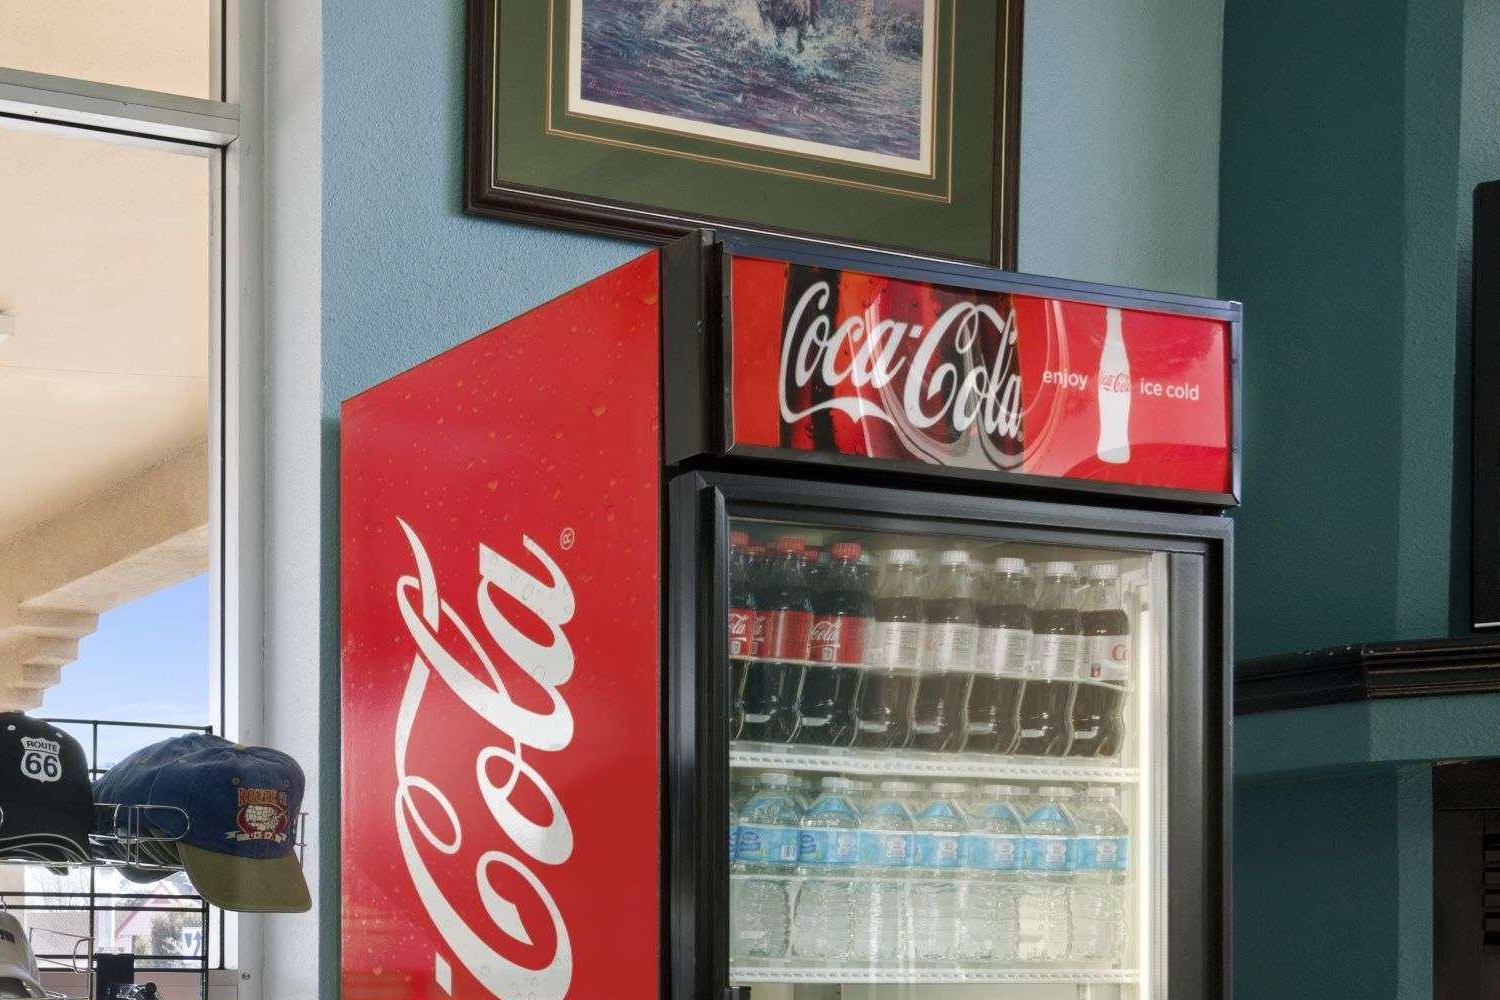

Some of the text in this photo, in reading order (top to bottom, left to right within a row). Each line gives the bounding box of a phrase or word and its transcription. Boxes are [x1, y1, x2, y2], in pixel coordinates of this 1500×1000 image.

[779, 281, 1022, 441] Coca-Cola
[1043, 370, 1088, 391] enjoy
[1140, 377, 1200, 401] ice cold
[27, 741, 59, 752] ROUTE
[26, 752, 58, 778] 66
